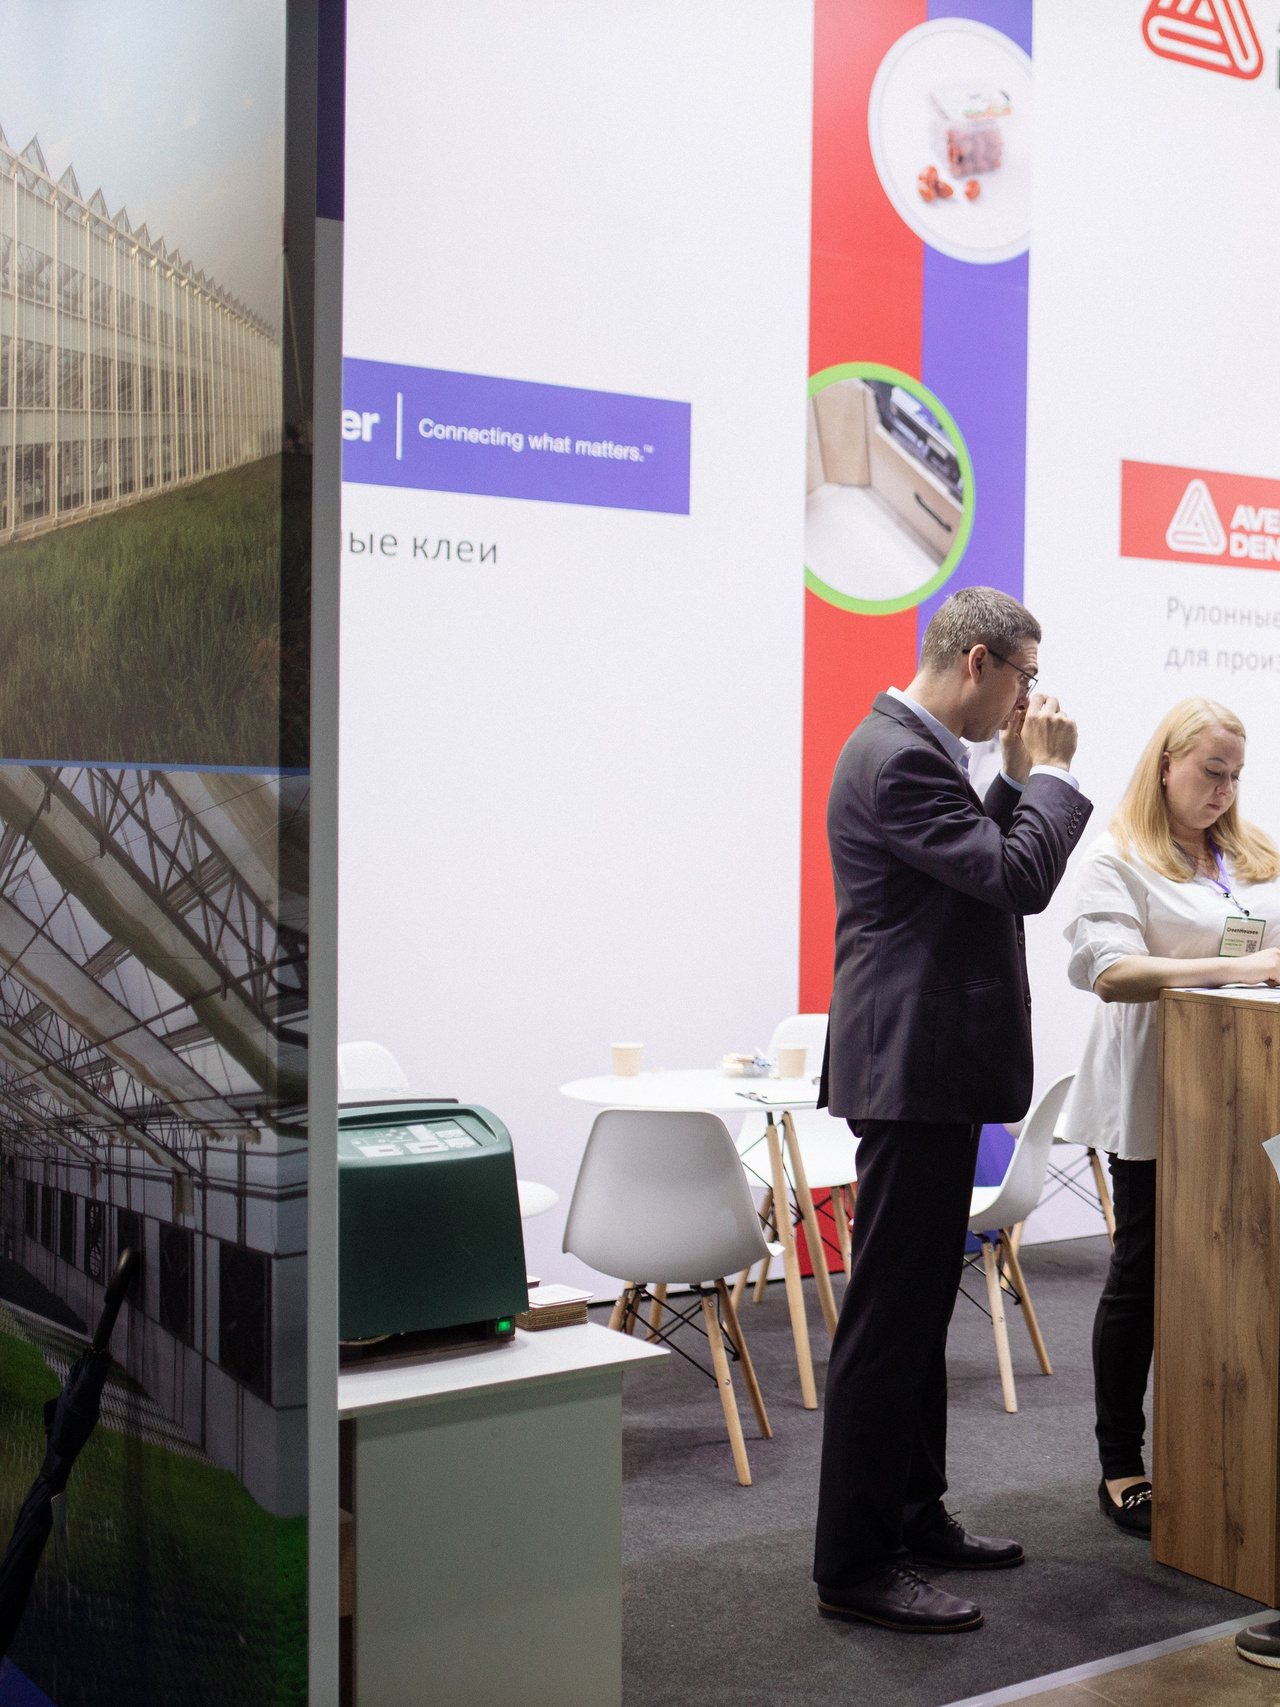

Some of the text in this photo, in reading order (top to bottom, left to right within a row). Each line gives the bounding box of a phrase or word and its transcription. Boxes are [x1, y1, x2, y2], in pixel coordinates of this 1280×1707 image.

[418, 418, 524, 452] Connecting
[528, 432, 571, 453] what
[342, 531, 498, 564] ые клеи
[1165, 648, 1209, 670] для
